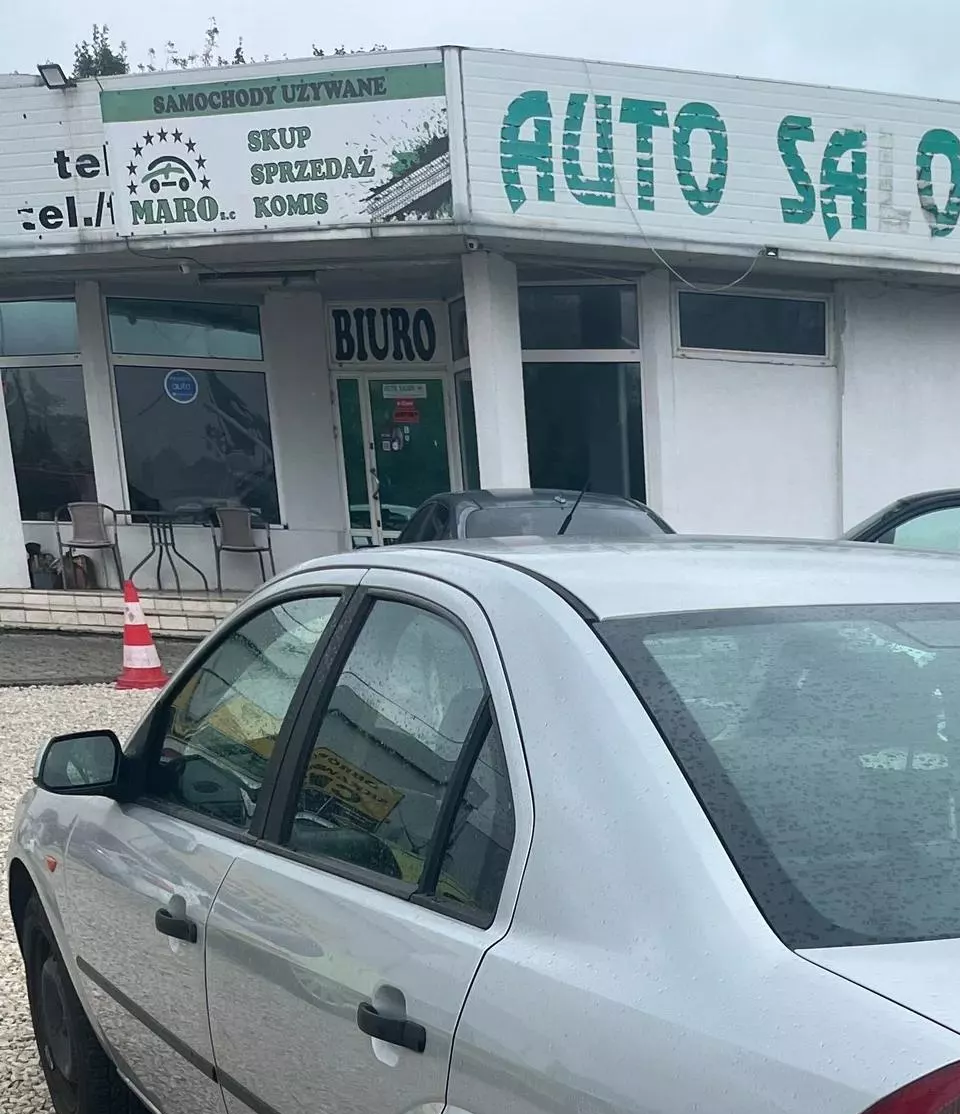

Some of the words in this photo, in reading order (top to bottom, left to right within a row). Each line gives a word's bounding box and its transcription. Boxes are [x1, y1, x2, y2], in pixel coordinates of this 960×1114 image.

[153, 86, 277, 114] SAMOCHODY
[247, 126, 312, 152] SKUP
[500, 90, 728, 216] AUTO
[250, 148, 375, 185] SPRZEDAŻ
[130, 196, 219, 225] MARO
[253, 192, 329, 218] KOMIS
[332, 307, 436, 361] BIURO
